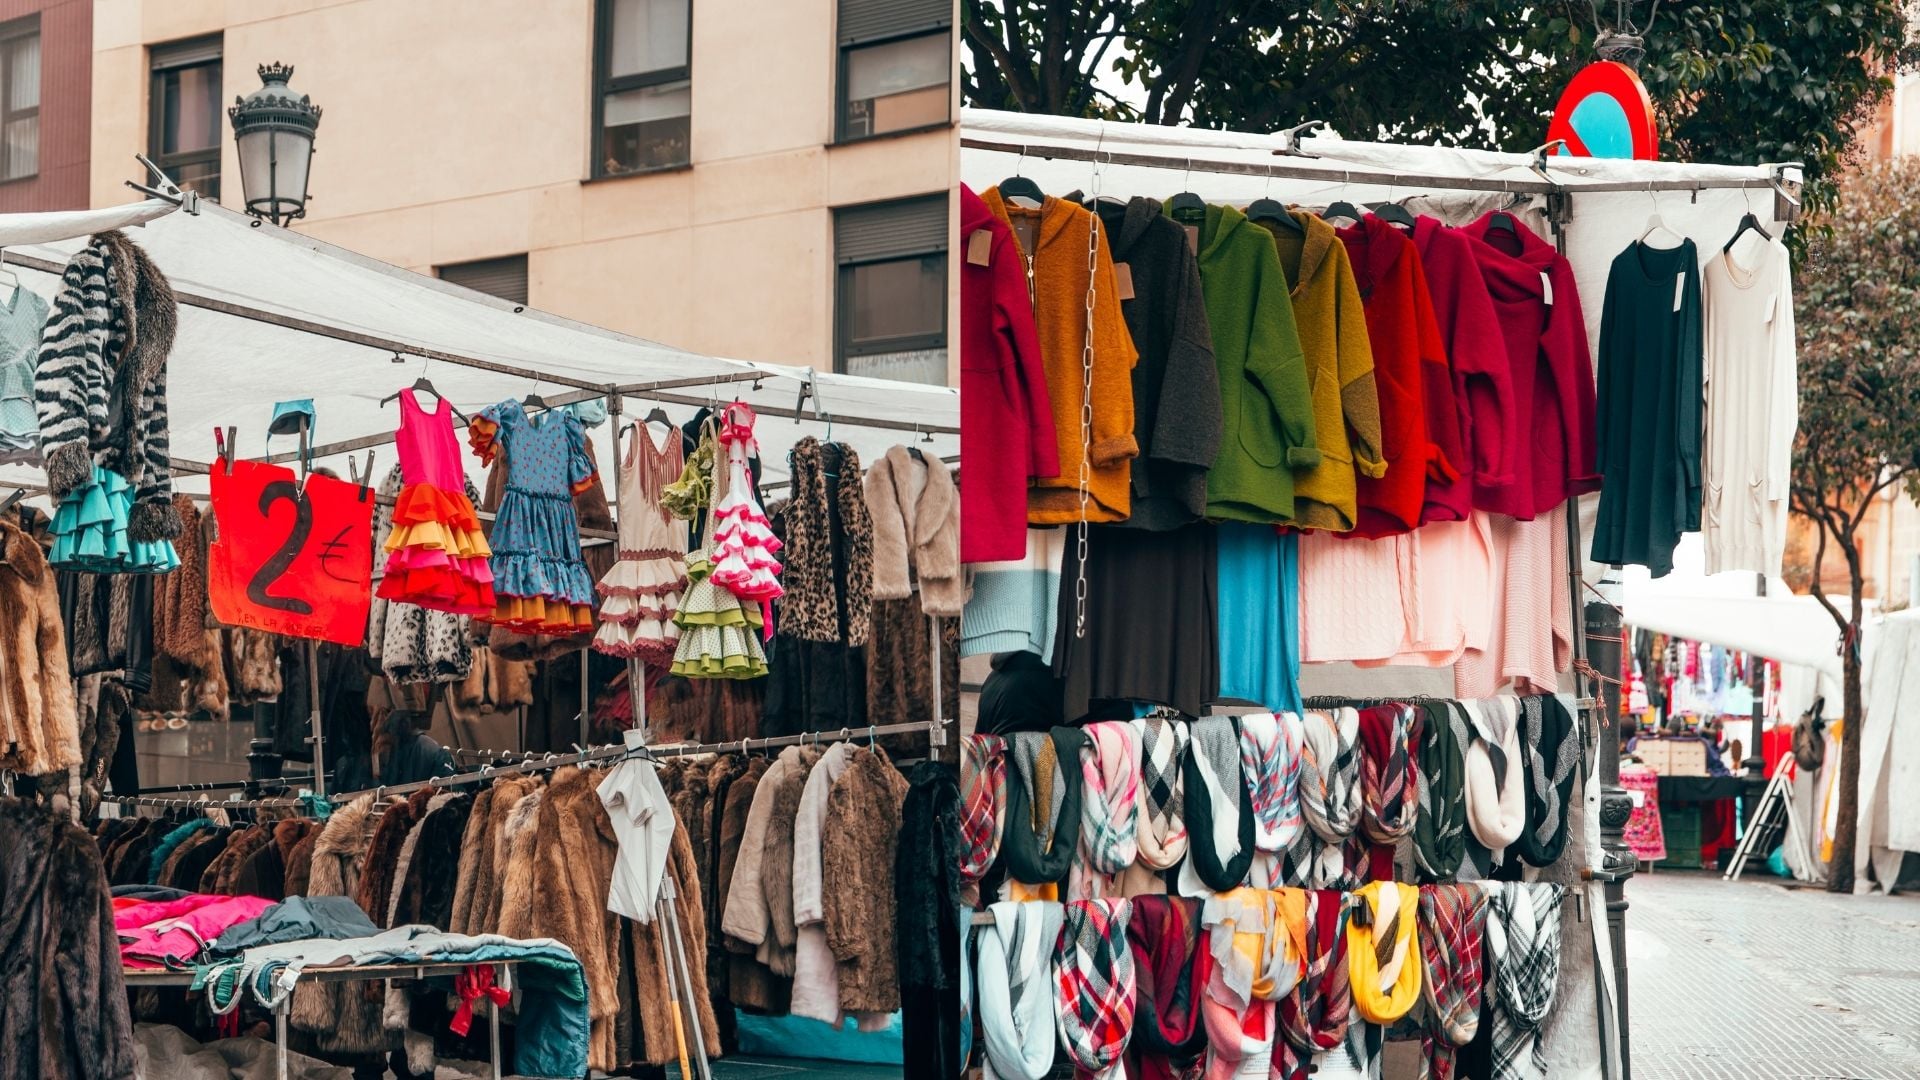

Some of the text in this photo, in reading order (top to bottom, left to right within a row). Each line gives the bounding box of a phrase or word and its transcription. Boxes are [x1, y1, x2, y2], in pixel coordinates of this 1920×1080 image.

[246, 480, 360, 615] 2 €
[263, 616, 278, 629] LA
